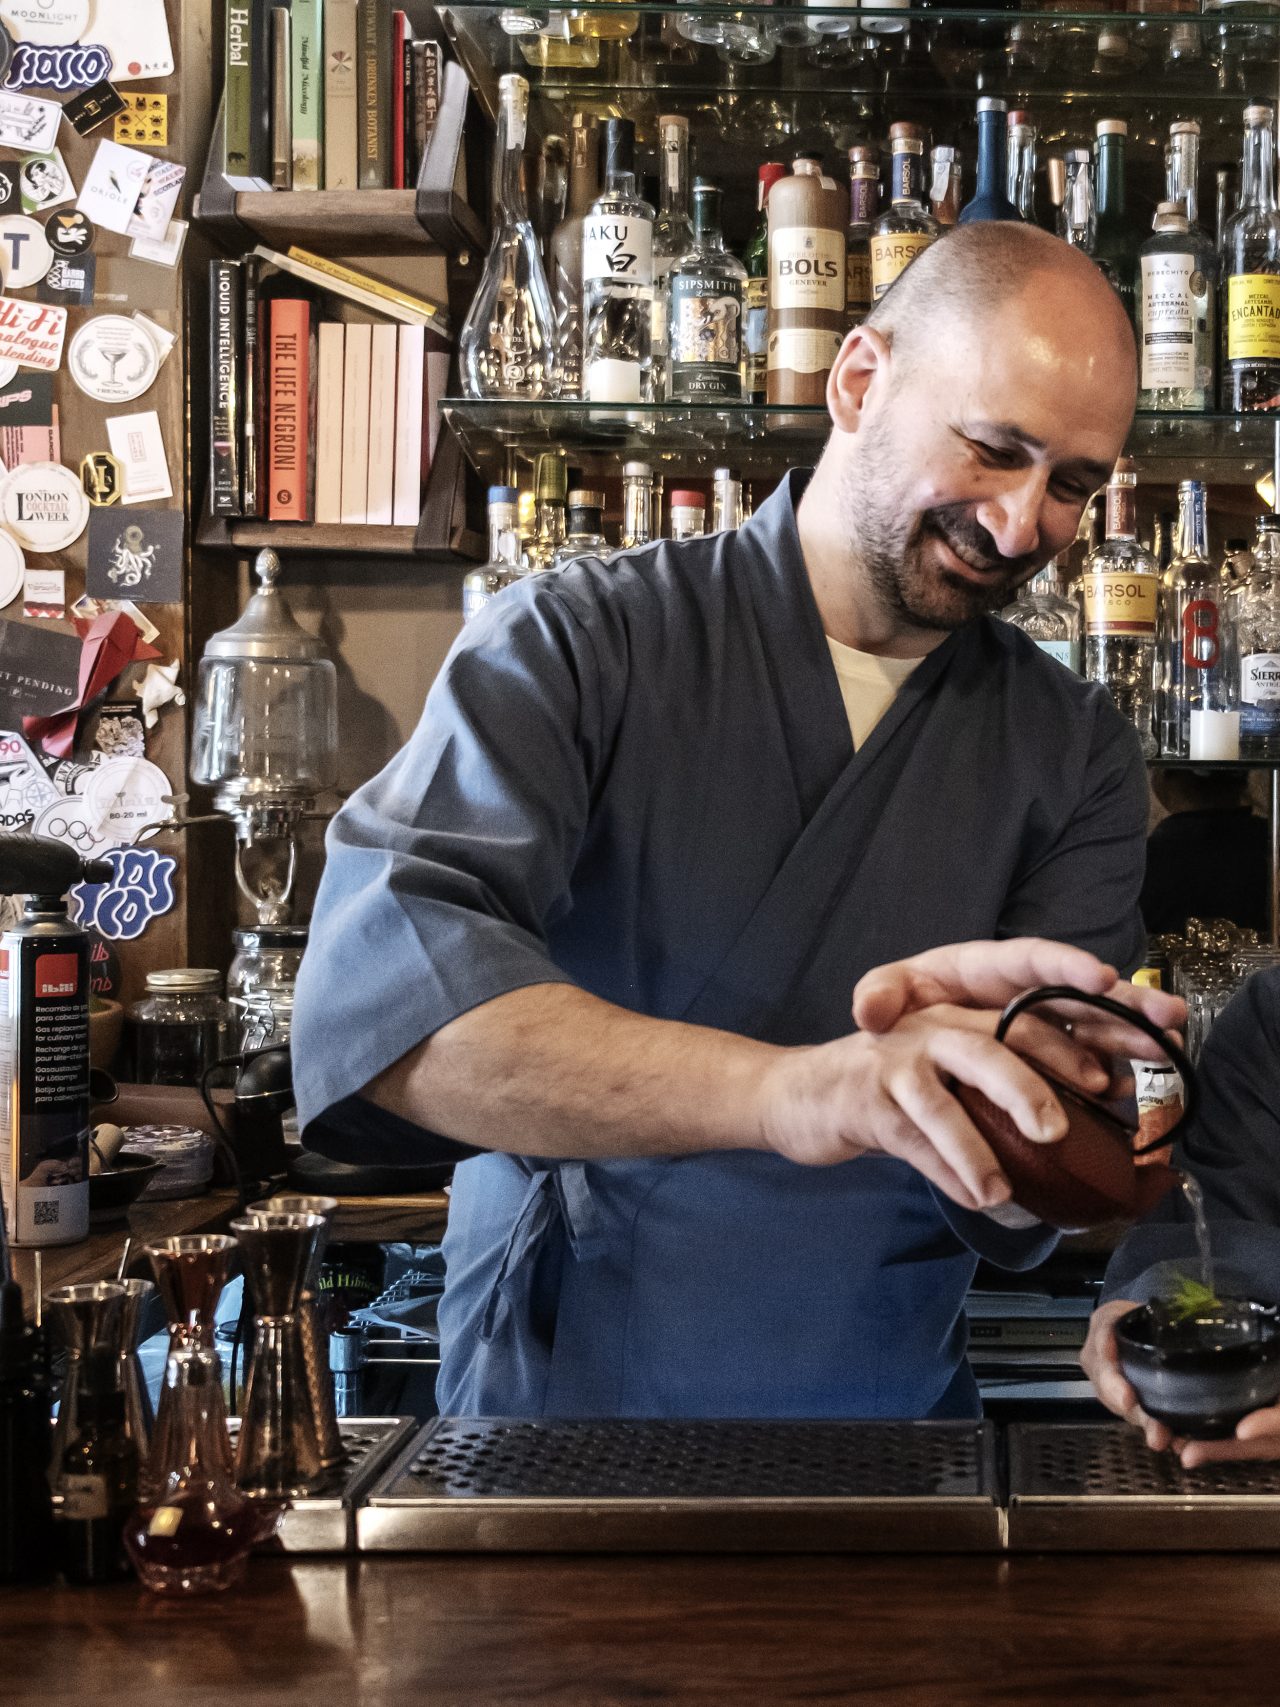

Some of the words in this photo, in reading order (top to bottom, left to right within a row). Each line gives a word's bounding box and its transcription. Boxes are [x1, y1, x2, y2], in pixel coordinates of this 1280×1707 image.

[11, 10, 78, 22] MOONLIGHT
[228, 7, 250, 66] Herbal
[367, 58, 378, 106] DRUNKEN
[367, 109, 378, 161] BOTANIST
[902, 157, 912, 197] BARSOL
[90, 185, 129, 205] ORIOLE
[858, 181, 869, 219] BARSOL
[586, 225, 629, 241] AKU
[778, 258, 839, 278] BOLS
[218, 269, 232, 314] LIQUID
[678, 279, 737, 292] SIPSMITH
[788, 279, 828, 288] GENEVER
[1147, 292, 1189, 300] MEZCAL
[275, 333, 297, 360] THE
[218, 317, 232, 409] INTELLIGENCE
[275, 367, 297, 397] LIFE
[688, 382, 706, 391] DRY
[709, 382, 727, 391] GIN
[274, 403, 297, 471] NEGRONI
[26, 503, 69, 513] COCKTAIL
[33, 512, 70, 522] WEEK
[1112, 491, 1122, 531] BARSOL
[1087, 584, 1146, 599] BARSOL
[17, 675, 73, 697] PENDING
[319, 1270, 333, 1290] ild
